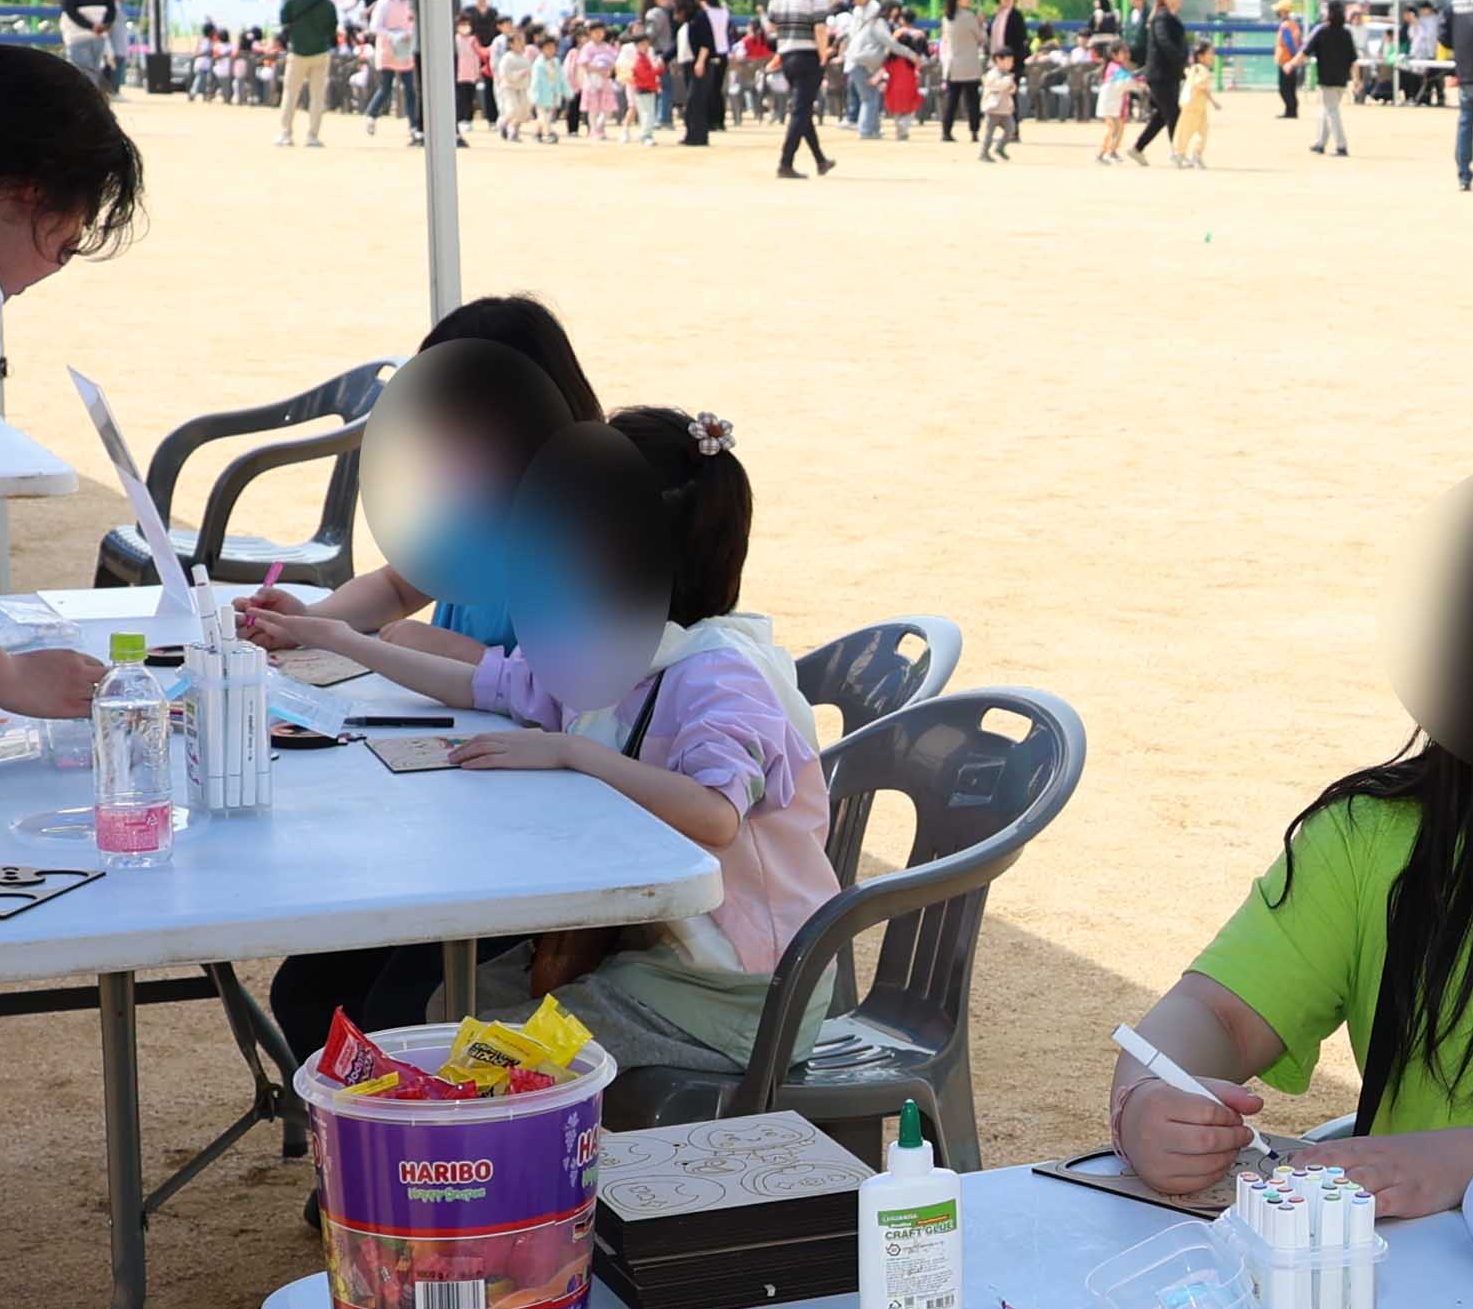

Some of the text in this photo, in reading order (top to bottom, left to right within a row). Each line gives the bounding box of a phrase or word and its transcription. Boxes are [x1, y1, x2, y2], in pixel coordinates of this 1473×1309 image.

[399, 1159, 494, 1185] HARIBO
[884, 1221, 955, 1241] CRAFT GLUE
